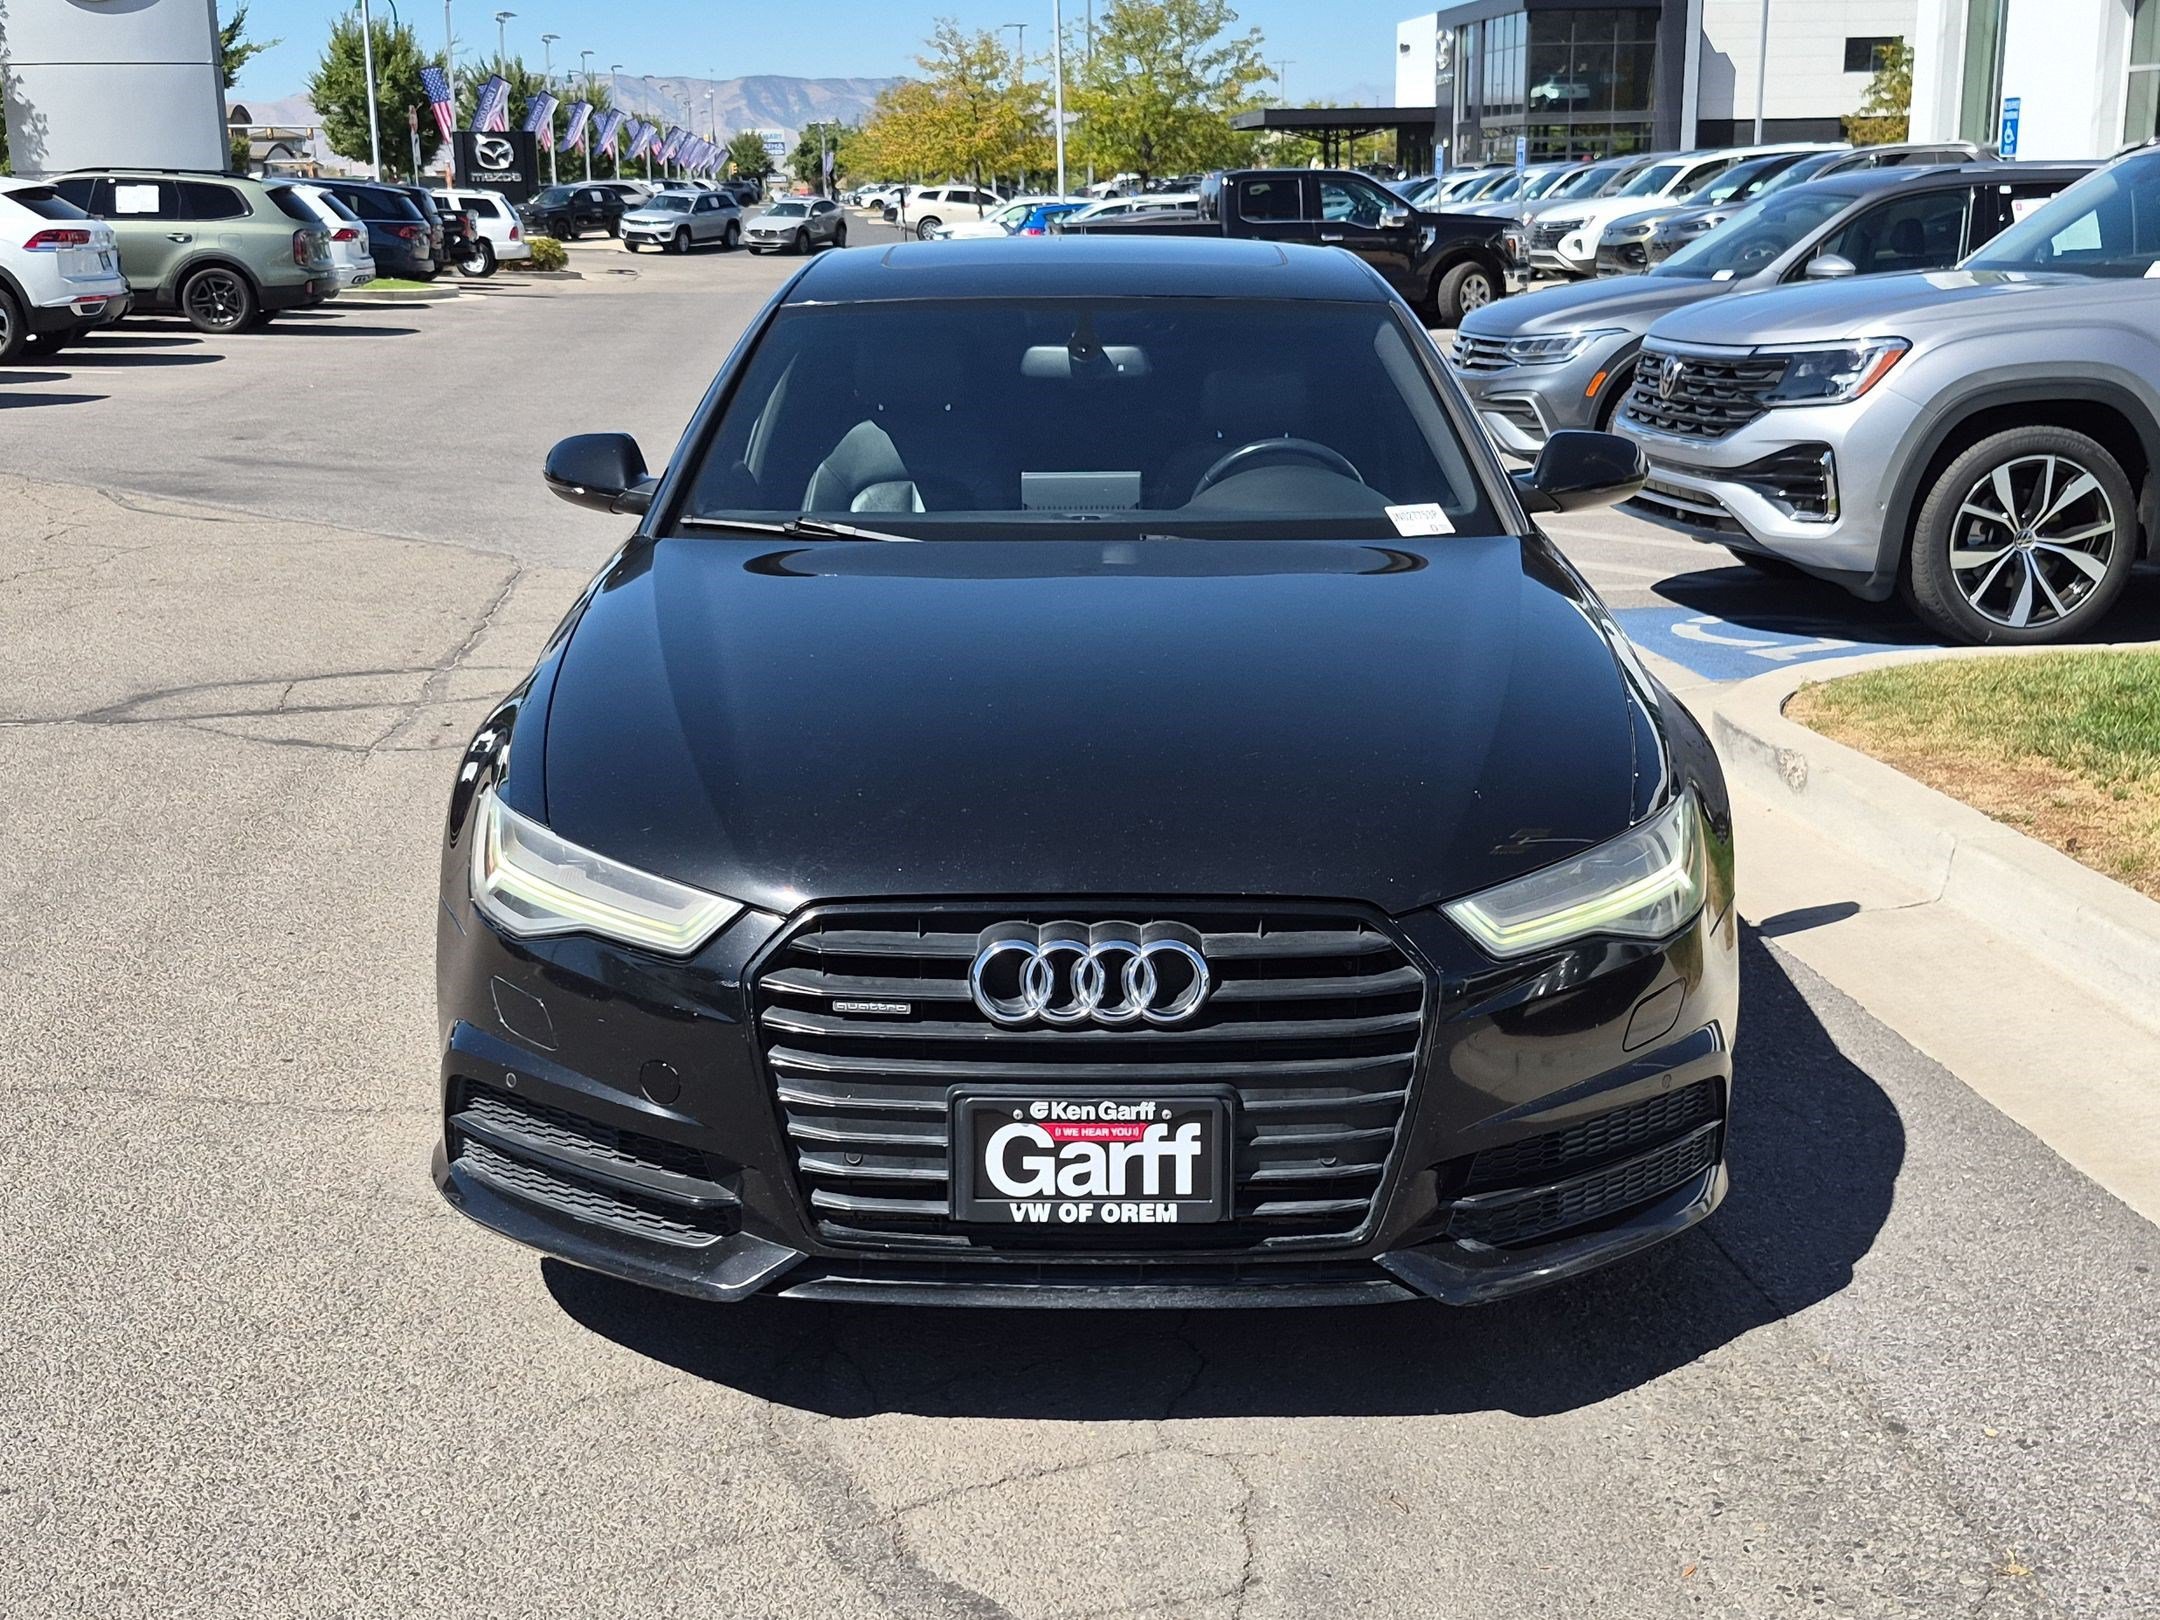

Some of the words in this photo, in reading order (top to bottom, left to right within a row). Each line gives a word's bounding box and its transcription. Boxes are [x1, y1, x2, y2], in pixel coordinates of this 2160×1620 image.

[836, 1002, 907, 1012] quattro
[1051, 1102, 1095, 1120] Ken
[1098, 1101, 1156, 1121] Garff
[1063, 1127, 1080, 1137] WE
[1081, 1127, 1110, 1137] HEAR
[1111, 1127, 1132, 1137] YOU
[985, 1122, 1202, 1198] Garff
[1010, 1203, 1052, 1223] VW
[1058, 1203, 1094, 1223] OF
[1101, 1203, 1178, 1223] OREM
